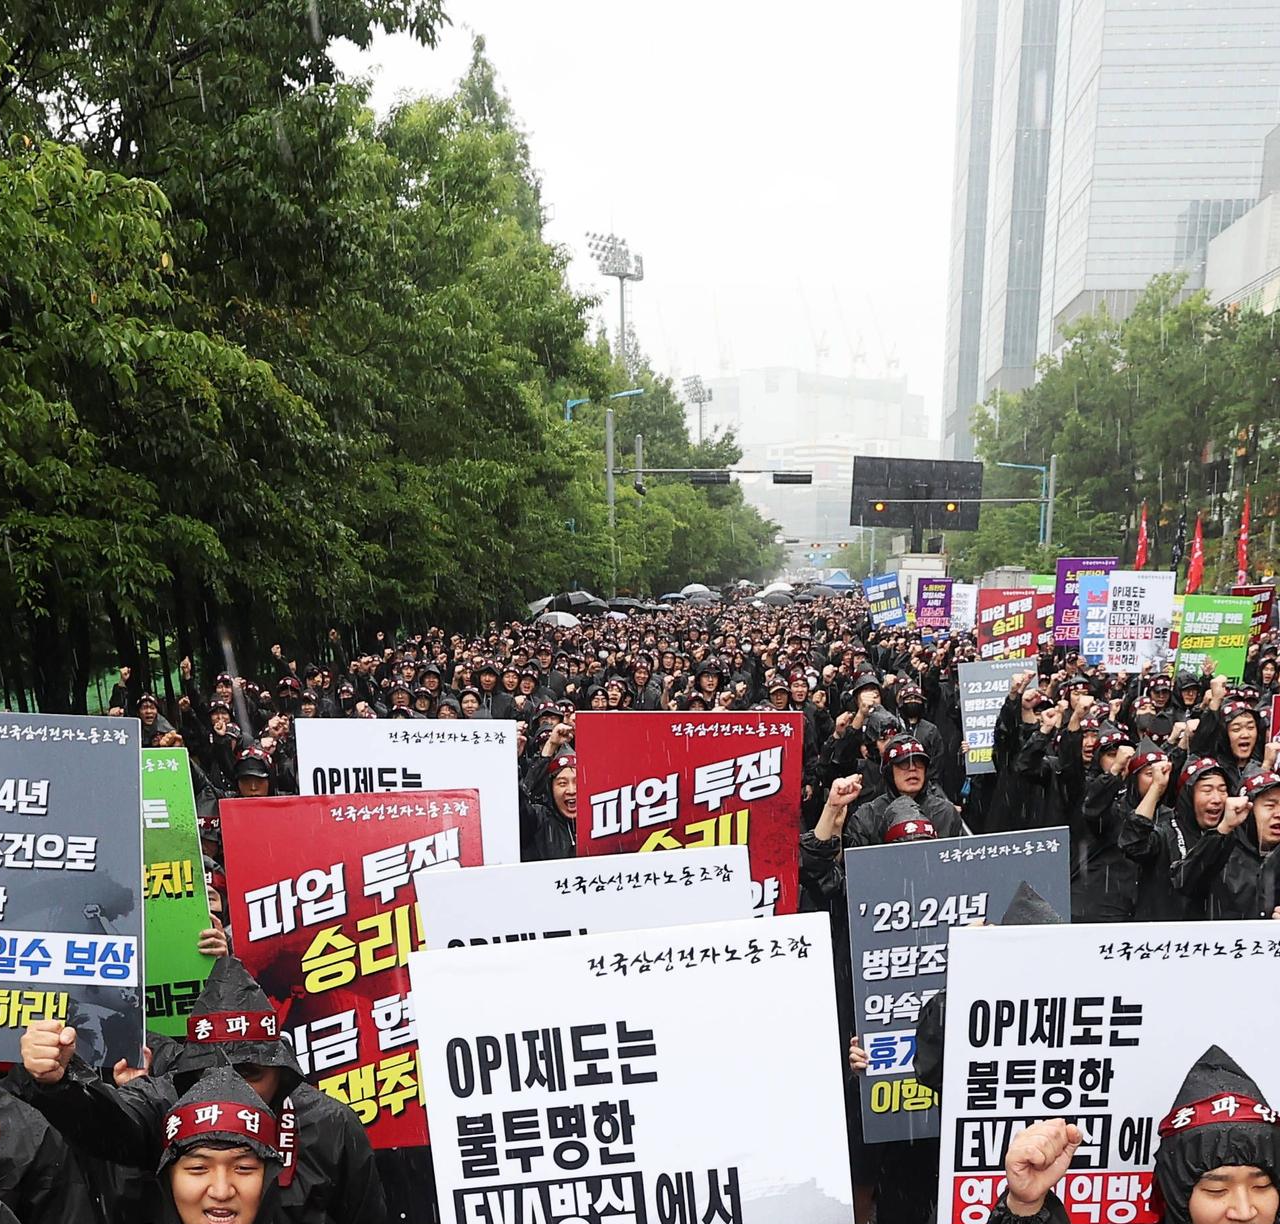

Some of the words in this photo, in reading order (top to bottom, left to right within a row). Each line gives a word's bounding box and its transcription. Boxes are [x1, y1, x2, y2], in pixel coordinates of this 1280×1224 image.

[1113, 586, 1147, 599] OPI제도는
[992, 614, 1024, 636] 승리!
[1140, 614, 1155, 626] 에서
[1108, 641, 1137, 653] 투명하게
[1181, 635, 1217, 649] 성과금
[1218, 634, 1246, 648] 잔치!
[1107, 653, 1139, 666] 개선하라!
[389, 729, 508, 745] 전국삼성전자노동조합
[671, 722, 794, 738] 전국삼성전자노동조합
[589, 772, 679, 840] 파업
[693, 745, 783, 812] 투쟁
[330, 799, 469, 822] 전국삼성전자노동조합
[938, 838, 1061, 865] 전국삼성전자노동조합
[554, 863, 735, 895] 전국삼성전자노동조합
[245, 862, 350, 943] 파업
[63, 937, 136, 979] 보상
[586, 935, 815, 978] 전국삼성전자노동조합
[862, 941, 948, 982] 병합조
[967, 996, 1144, 1049] OPI제도는
[445, 1019, 659, 1099] OPI제도는
[966, 1057, 1115, 1111] 불투명한
[455, 1099, 637, 1181] 불투명한
